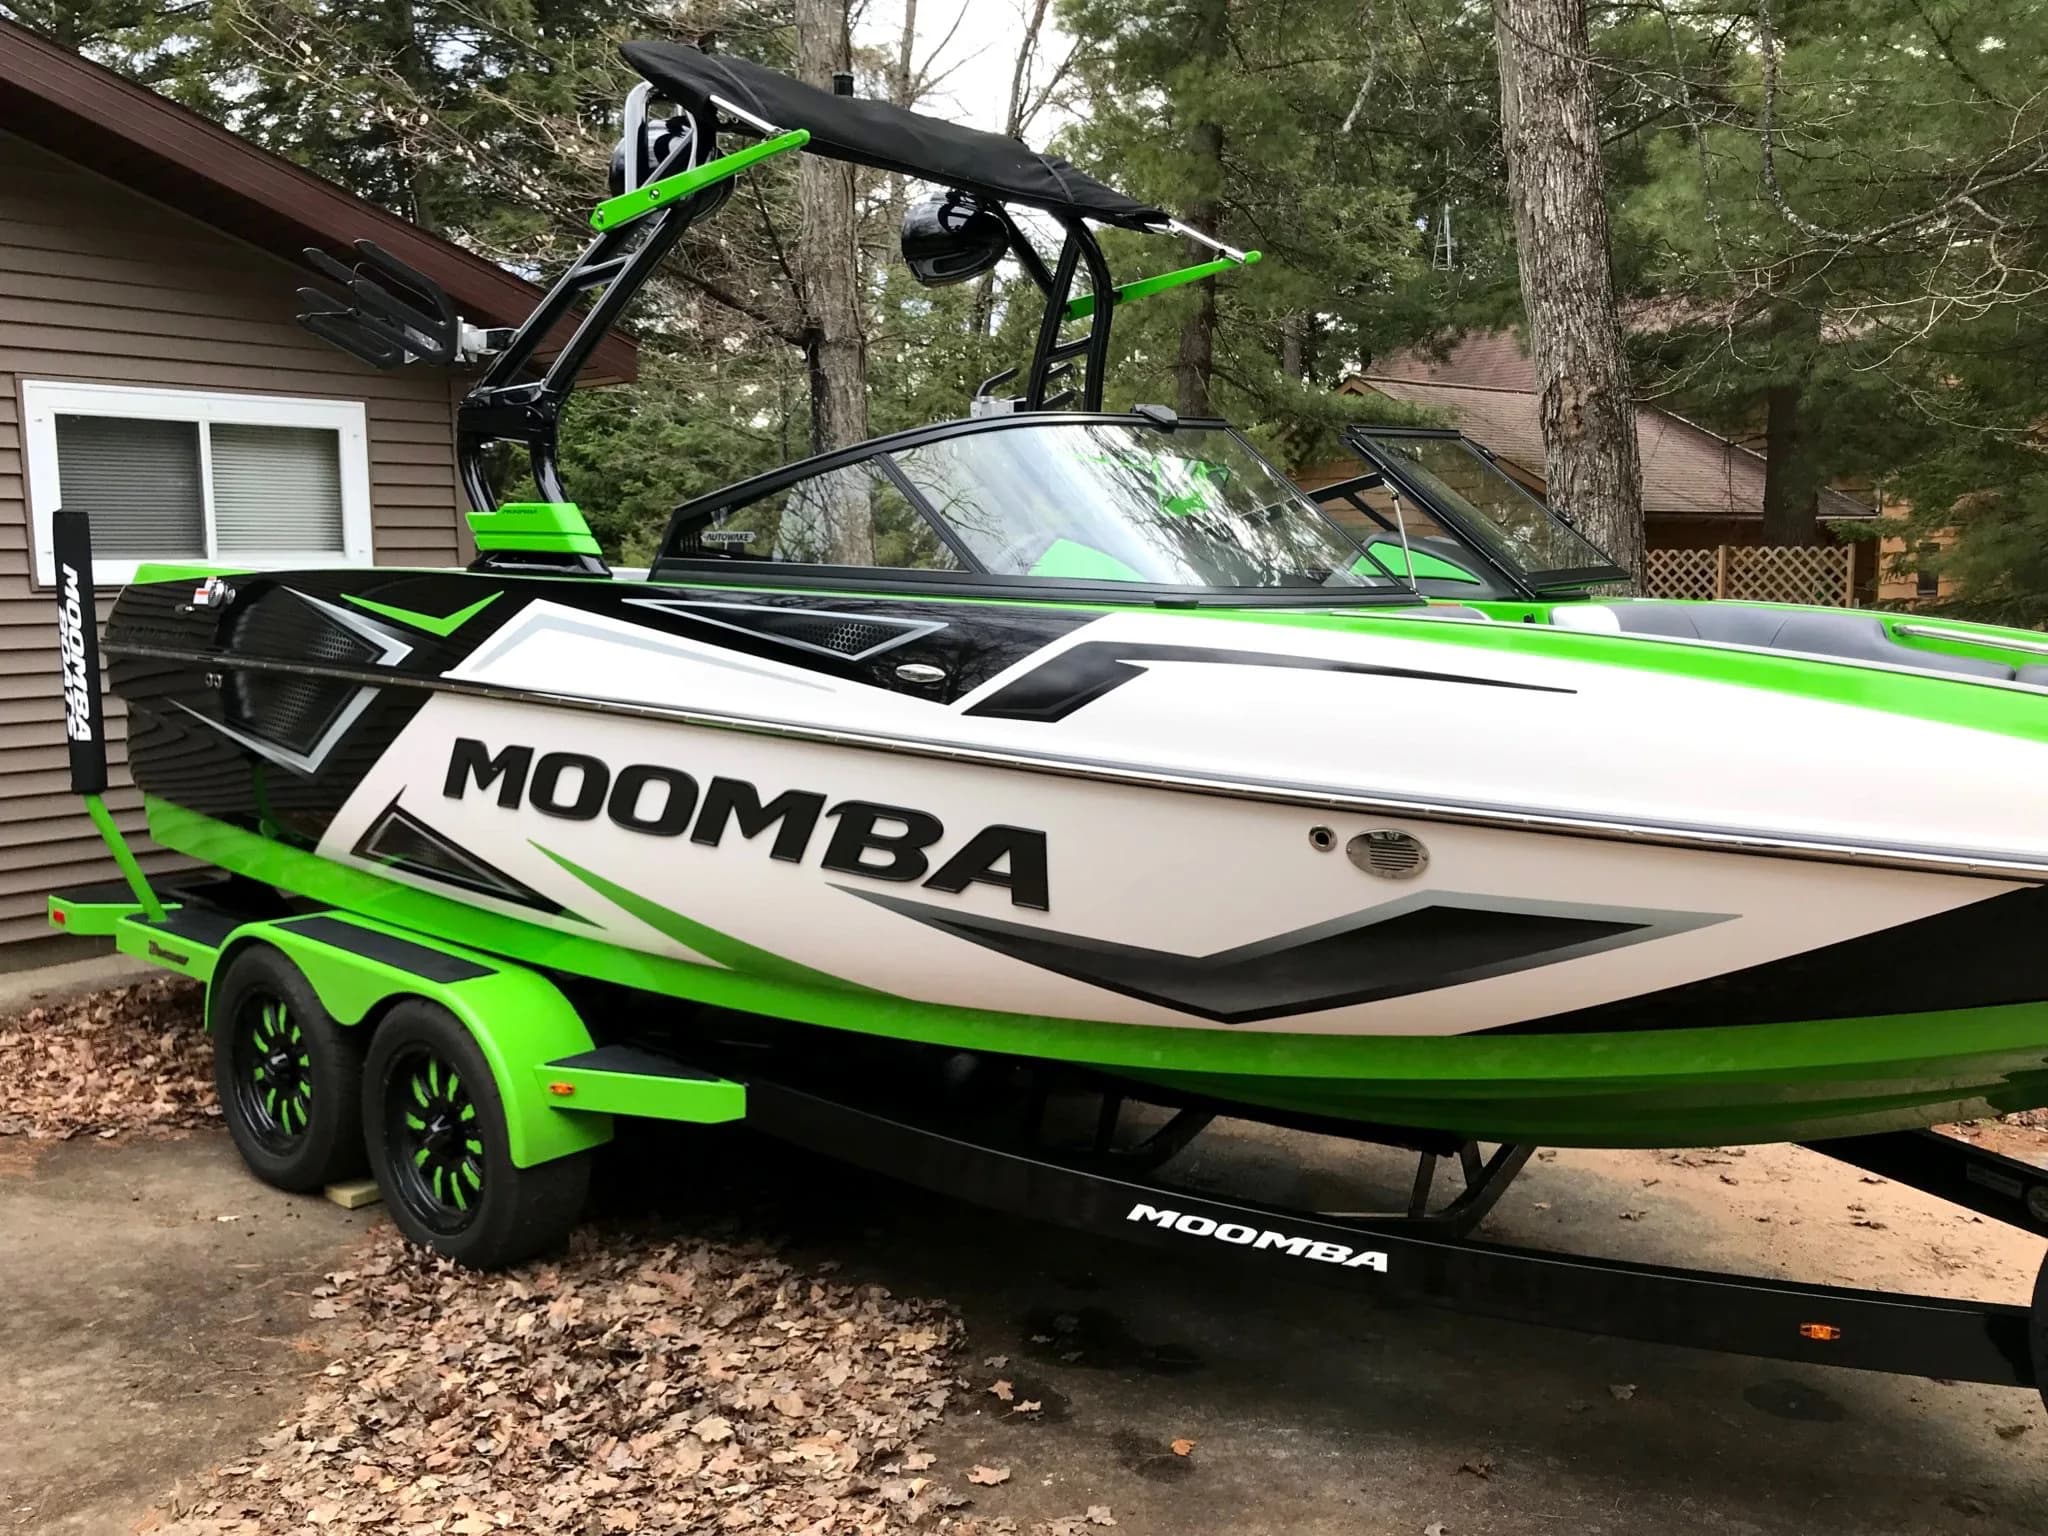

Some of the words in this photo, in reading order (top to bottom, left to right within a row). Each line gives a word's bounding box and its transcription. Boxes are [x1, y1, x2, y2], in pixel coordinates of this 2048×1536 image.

[706, 532, 749, 542] AUTOWAKE
[58, 605, 78, 740] BOATS
[62, 562, 92, 741] MOOMBA
[442, 737, 1050, 912] MOOMBA
[1126, 1203, 1388, 1272] MOOMBA
